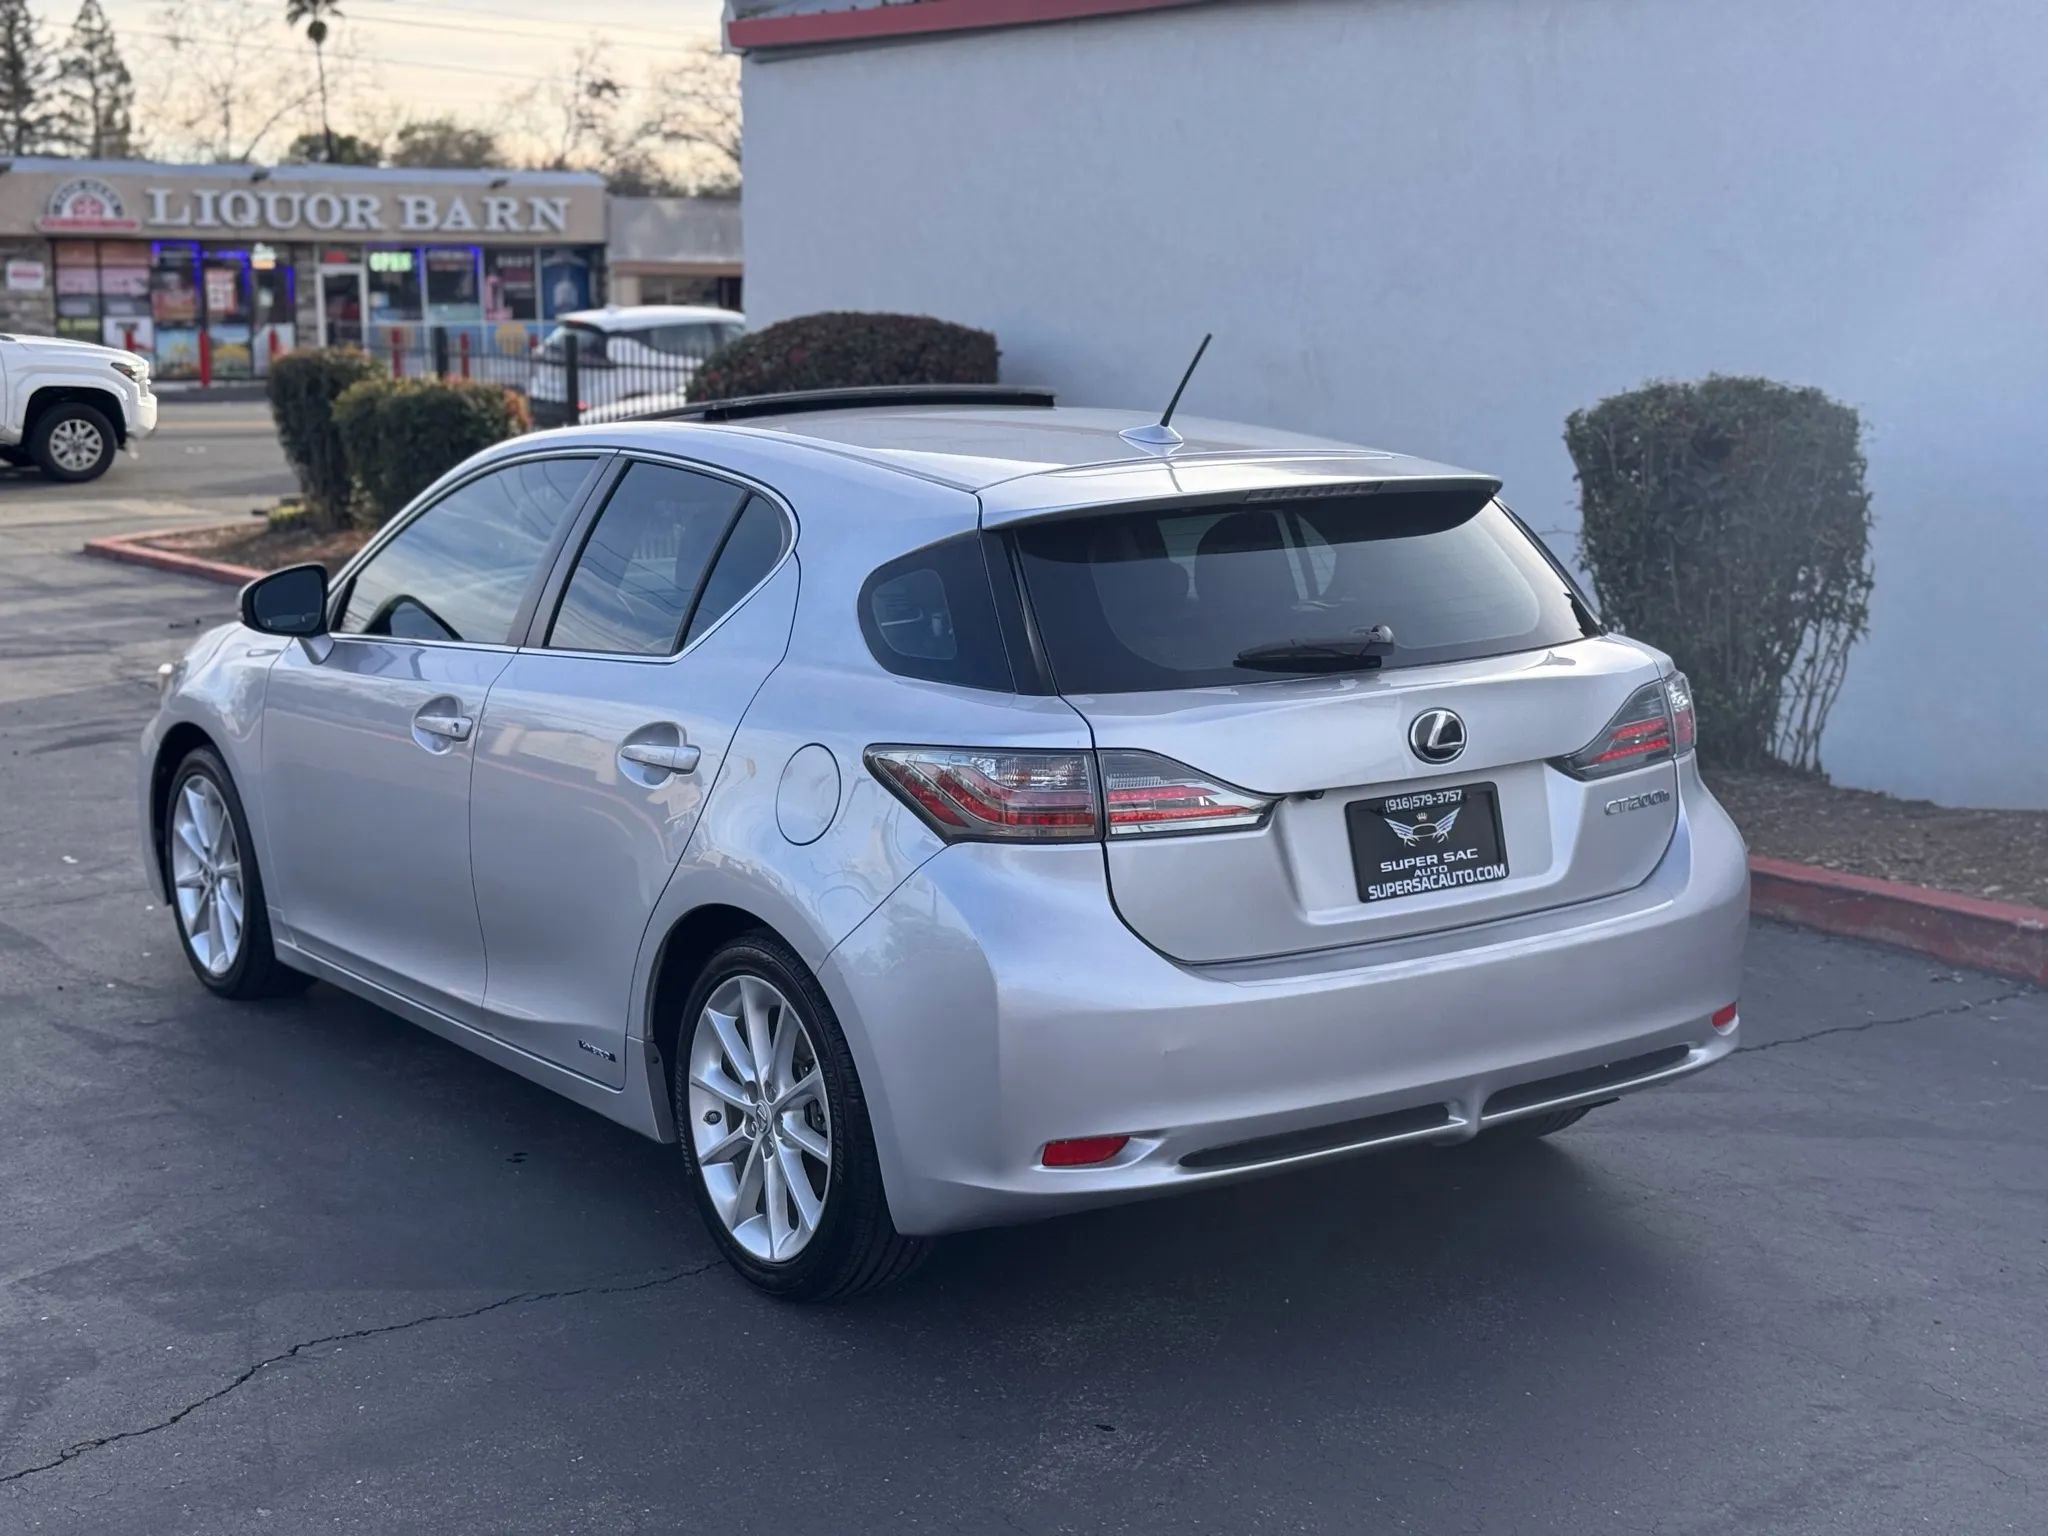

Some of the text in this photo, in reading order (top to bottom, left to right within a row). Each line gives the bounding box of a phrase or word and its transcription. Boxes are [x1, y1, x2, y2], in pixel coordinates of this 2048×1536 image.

[146, 188, 383, 230] LIQUOR
[399, 193, 571, 233] BARN
[1385, 790, 1462, 813] (916)579-3757
[1380, 848, 1479, 873] SUPER SAC
[1414, 865, 1448, 877] AUTO
[1367, 863, 1506, 900] SUPERSACAUTO.COM
